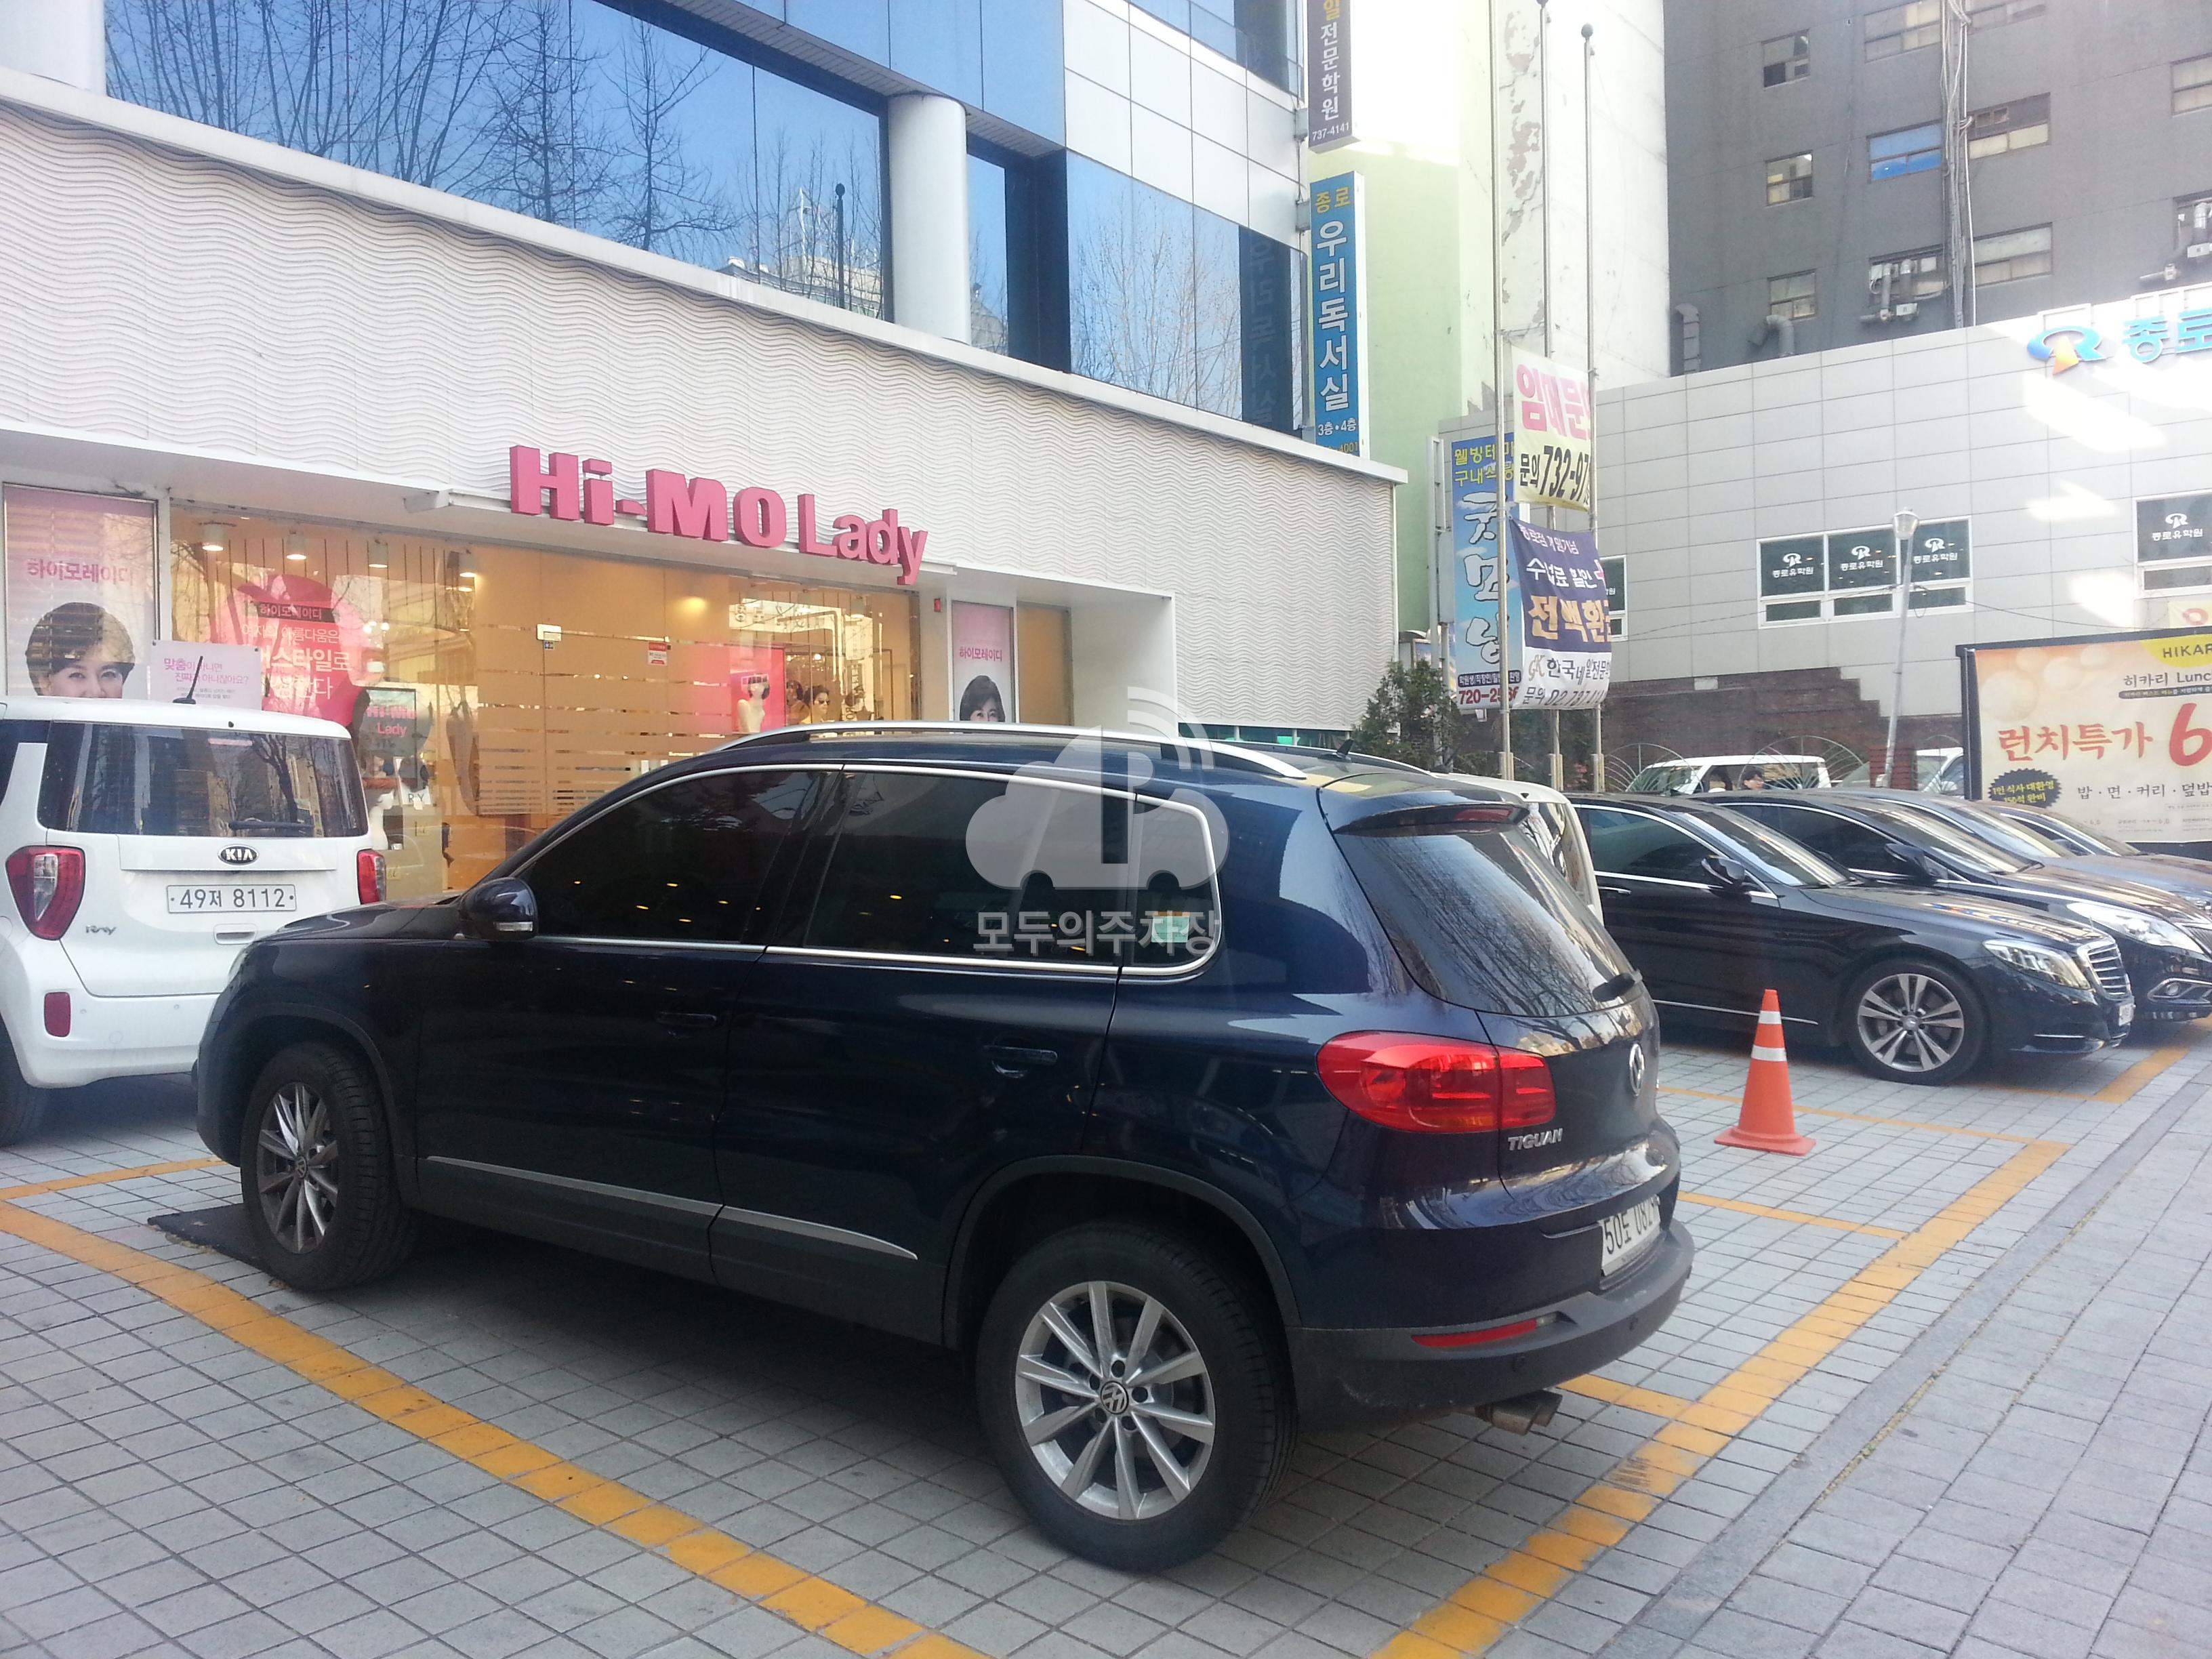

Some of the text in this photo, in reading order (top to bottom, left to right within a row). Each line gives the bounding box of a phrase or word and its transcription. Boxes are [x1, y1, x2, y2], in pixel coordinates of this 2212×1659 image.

[1312, 122, 1350, 141] 737-4141
[1315, 186, 1350, 213] 종로
[1317, 220, 1349, 413] 우리독서실
[1520, 453, 1540, 488] 문의
[510, 445, 928, 586] Hi-MO Lady
[2152, 528, 2203, 541] 종로유학원
[1840, 560, 1883, 571] 종로유학원
[1914, 552, 1958, 565] 종로유학원
[27, 558, 133, 586] 하이모레이디
[1772, 567, 1814, 578] 종로유학원
[960, 647, 1002, 661] 하이모레이디
[2123, 672, 2169, 687] 히카리
[1999, 721, 2154, 762] 런치특가
[2137, 784, 2165, 798] 커리
[225, 848, 253, 861] KIA
[180, 888, 285, 909] 49저 8112
[1508, 1128, 1563, 1151] TIGUAN
